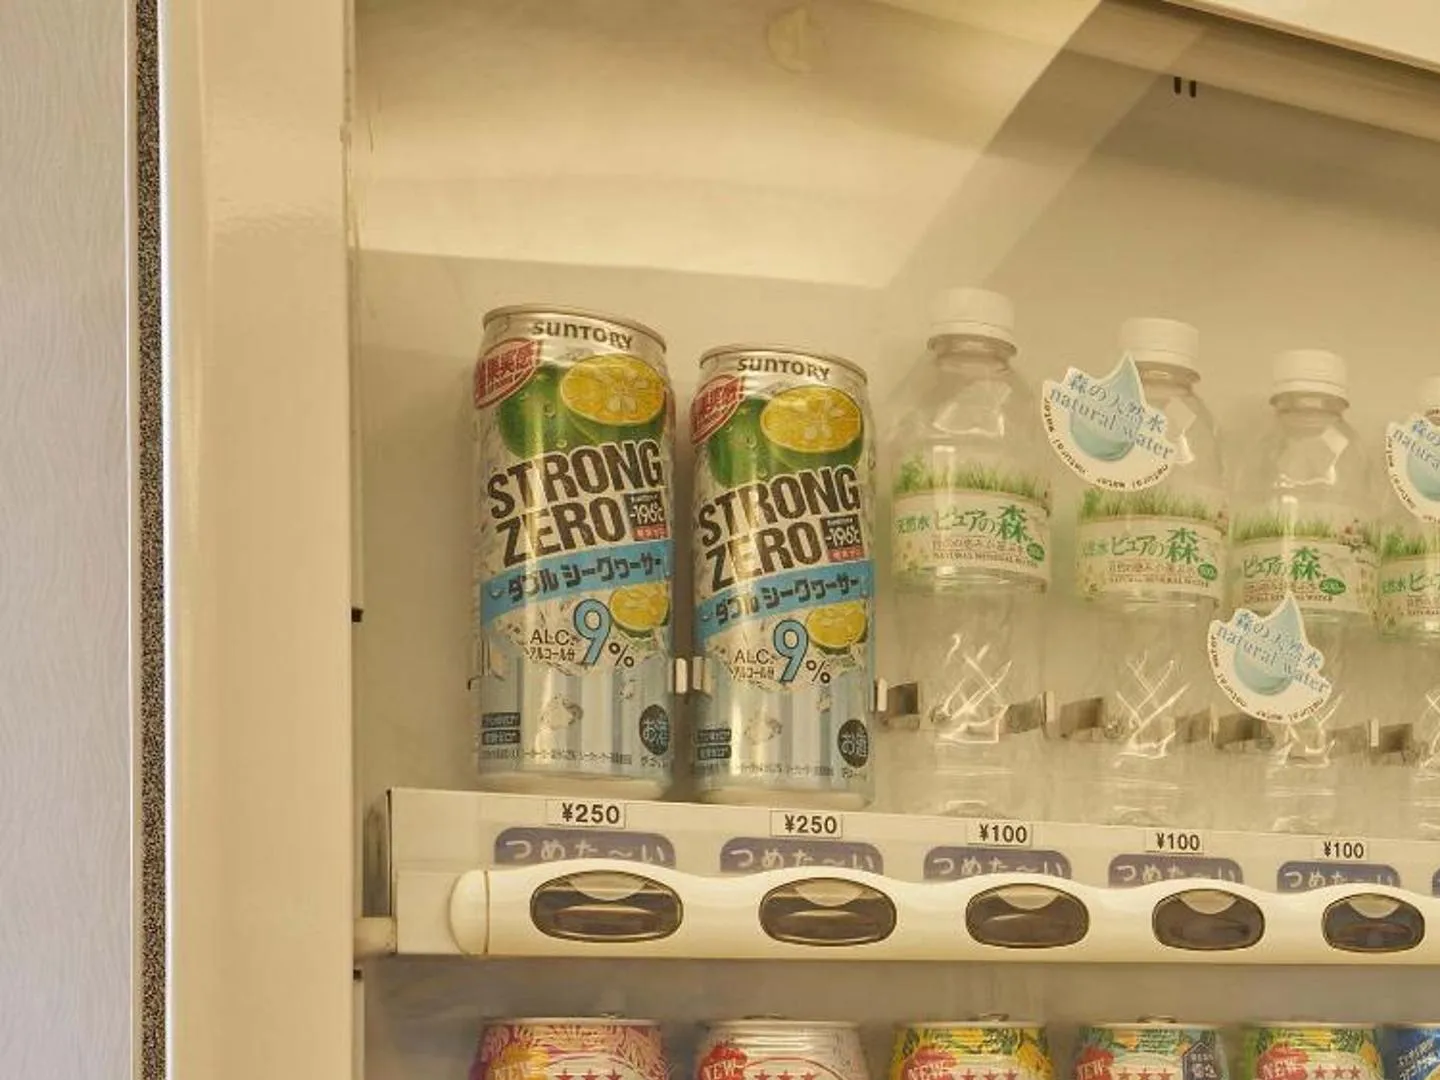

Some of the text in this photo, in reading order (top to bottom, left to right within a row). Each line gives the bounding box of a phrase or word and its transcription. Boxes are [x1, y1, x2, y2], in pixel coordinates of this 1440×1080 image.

[532, 320, 634, 350] SUNTORY
[737, 357, 830, 381] SUNTORY
[1050, 388, 1117, 431] natural
[487, 440, 664, 519] STRONG
[699, 465, 860, 548] STRONG
[497, 496, 627, 567] ZERO
[706, 521, 823, 594] ZERO
[1216, 626, 1278, 667] natural
[561, 803, 621, 825] ¥250
[783, 814, 837, 835] ¥250
[978, 825, 1028, 844] ¥100
[1155, 832, 1201, 851] ¥100
[1323, 841, 1365, 859] ¥100
[1260, 1060, 1299, 1080] NEW
